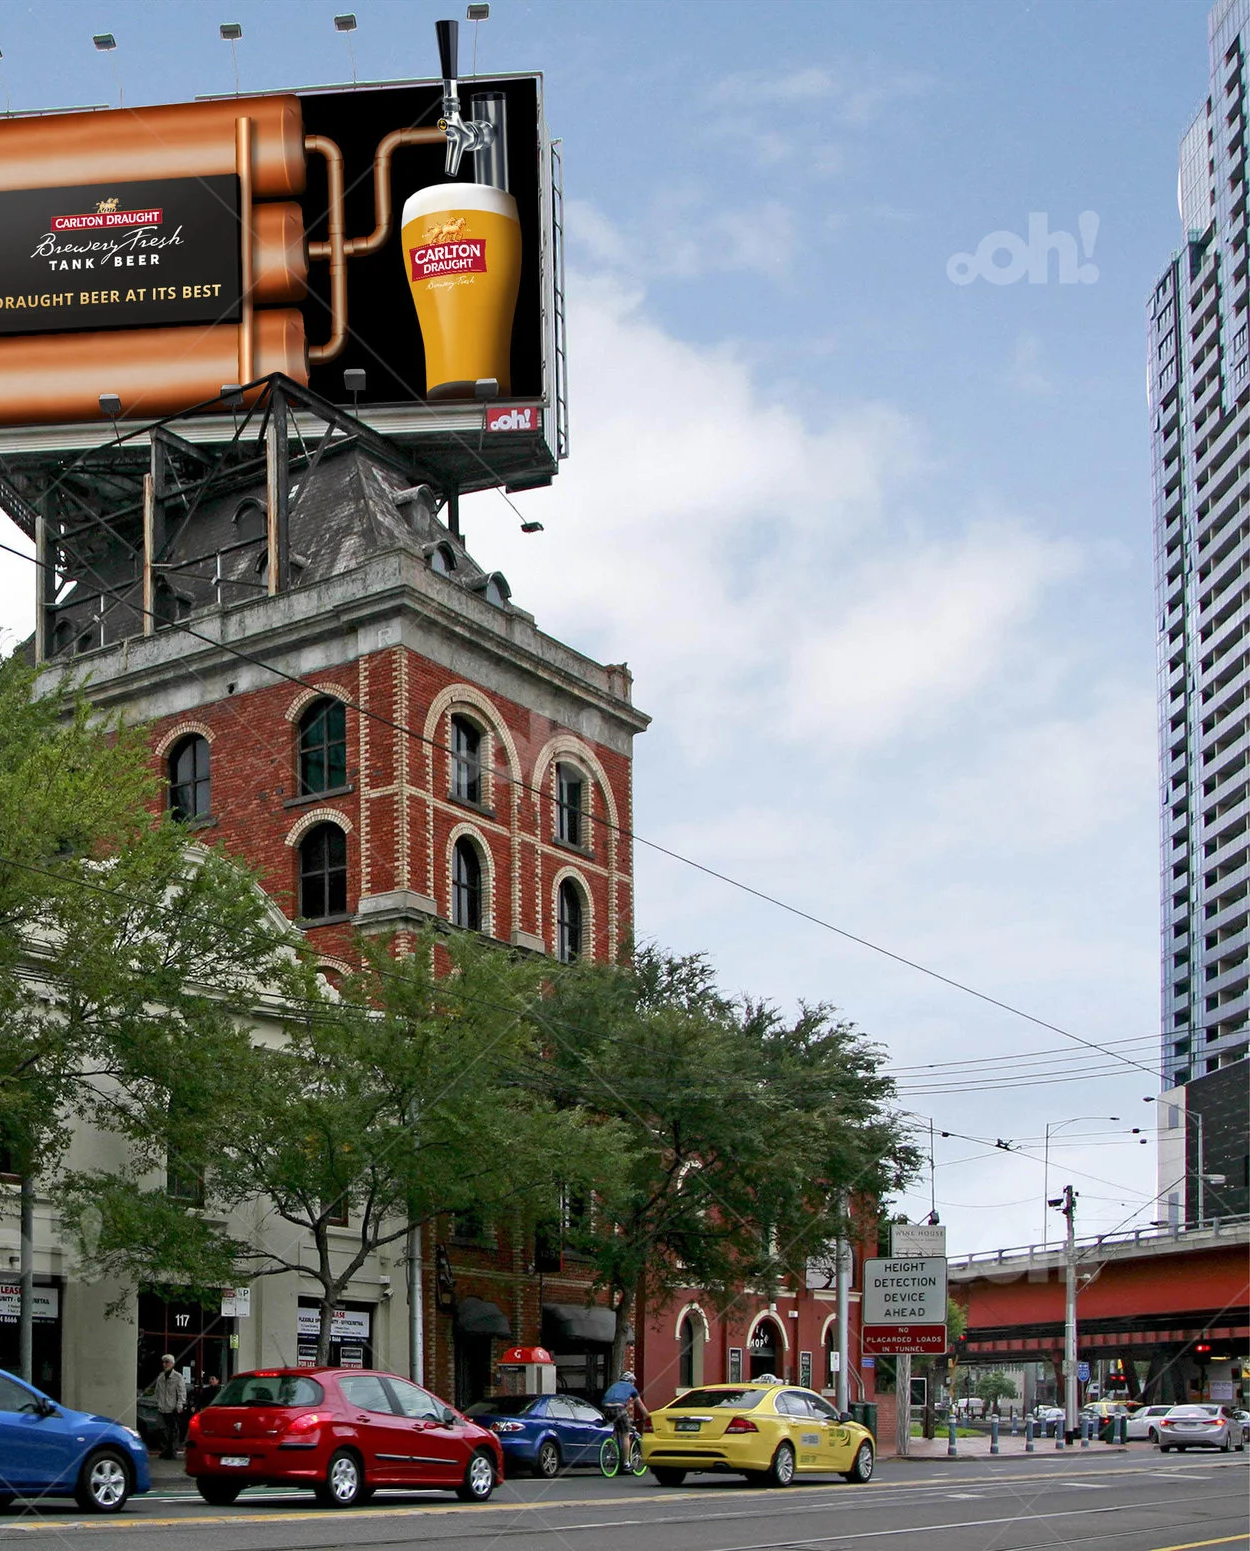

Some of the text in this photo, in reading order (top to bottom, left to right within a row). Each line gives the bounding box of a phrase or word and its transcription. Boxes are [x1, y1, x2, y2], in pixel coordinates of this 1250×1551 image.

[55, 211, 160, 229] CARLTON DRAUGHT
[30, 225, 184, 265] Brewery Fresh
[49, 254, 160, 271] TANK BEER
[414, 244, 481, 265] CARLTON
[423, 258, 474, 274] DRAUGHT
[80, 290, 120, 305] BEER
[125, 288, 146, 302] AT
[152, 287, 177, 300] ITS
[182, 284, 222, 299] BEST
[884, 1262, 926, 1273] HEIGHT
[874, 1277, 937, 1288] DETECTION
[884, 1292, 925, 1303] DEVICE
[884, 1307, 926, 1317] AHEAD
[175, 1314, 190, 1327] 117
